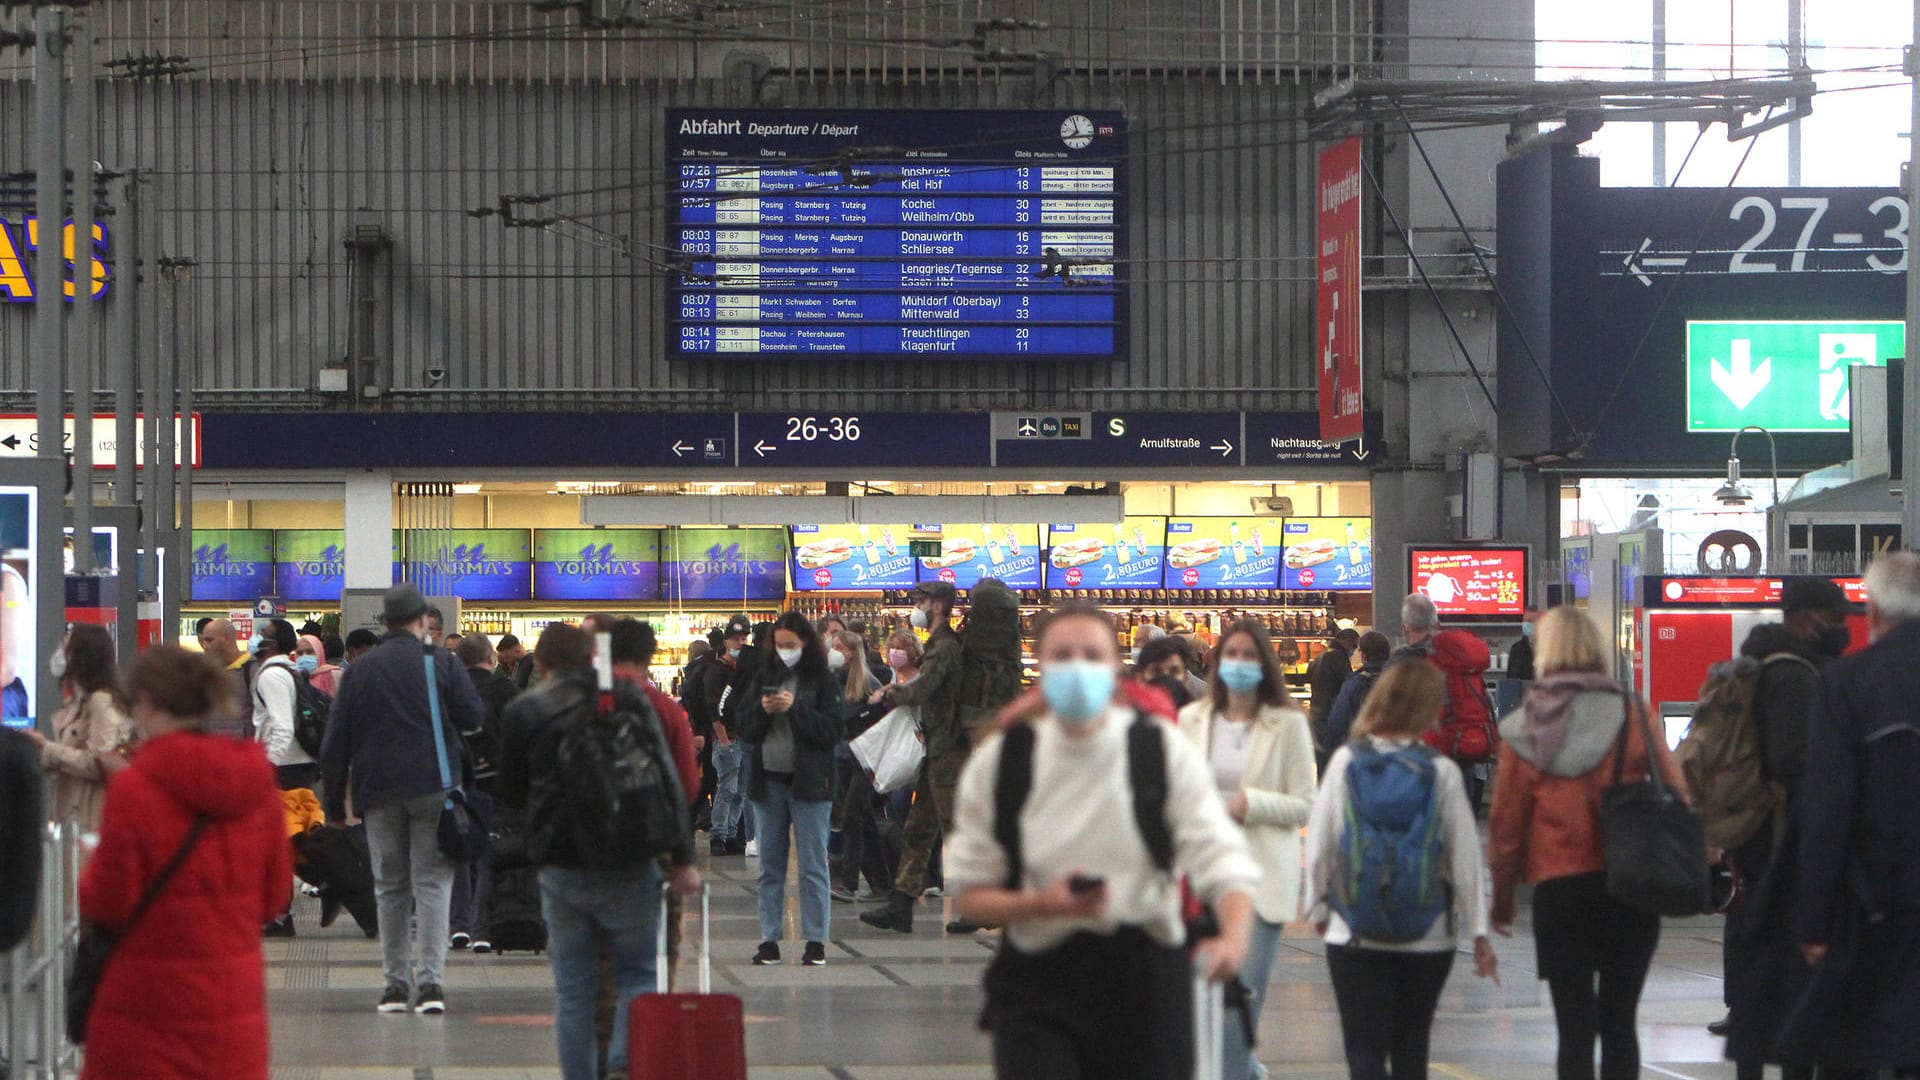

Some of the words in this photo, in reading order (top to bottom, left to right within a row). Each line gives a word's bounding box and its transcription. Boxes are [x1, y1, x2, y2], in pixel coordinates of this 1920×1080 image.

[680, 119, 741, 135] Abfahrt
[748, 123, 809, 137] Departure
[821, 124, 858, 137] Départ
[760, 148, 776, 156] Über
[901, 167, 950, 177] Innsbruck
[1016, 167, 1030, 177] 13
[682, 179, 710, 189] 07:57
[761, 182, 794, 190] Augsburg
[901, 180, 920, 190] Kiel
[925, 180, 942, 190] Hbf
[1016, 180, 1030, 190] 18
[761, 201, 784, 210] Pasing
[795, 201, 830, 210] Starnberg
[841, 201, 866, 210] Tutzing
[901, 200, 936, 209] Kochel
[1016, 200, 1030, 209] 30
[761, 214, 784, 223] Pasing
[795, 214, 830, 223] Starnberg
[841, 214, 866, 223] Tutzing
[901, 212, 974, 222] Weilheim/Obb
[1016, 212, 1030, 222] 30
[682, 230, 710, 241] 08:03
[761, 234, 784, 243] Pasing
[795, 234, 819, 243] Mering
[830, 234, 864, 243] Augsburg
[901, 231, 964, 242] Donauwörth
[1016, 232, 1030, 242] 16
[682, 243, 710, 253] 08:03
[761, 247, 821, 255] Donnersbergerbr.
[832, 247, 856, 255] Harras
[901, 245, 954, 255] Schliersee
[1016, 245, 1030, 255] 32
[716, 264, 725, 272] RB
[730, 264, 752, 272] 56/57
[761, 266, 821, 275] Donnersbergerbr.
[832, 266, 856, 275] Harras
[901, 264, 1002, 276] Lenggries/Tegernse
[1016, 264, 1030, 274] 32
[936, 276, 954, 287] Hbf
[682, 295, 710, 305] 08:07
[716, 296, 725, 304] RB
[761, 298, 783, 306] Markt
[786, 298, 822, 306] Schwaben
[832, 298, 856, 306] Dorfen
[901, 296, 948, 306] Mühldorf
[952, 296, 1002, 308] (Oberbay)
[1022, 296, 1030, 306] 8
[682, 308, 710, 318] 08:13
[761, 311, 784, 320] Pasing
[795, 311, 826, 320] Weilheim
[838, 311, 864, 320] Murnau
[901, 309, 960, 319] Mittenwald
[1016, 309, 1030, 319] 33
[682, 327, 710, 337] 08:14
[761, 330, 786, 338] Dachau
[798, 330, 845, 338] Petershausen
[902, 328, 970, 340] Treuchtlingen
[1016, 328, 1030, 339] 20
[682, 340, 710, 350] 08:17
[761, 343, 798, 351] Rosenheim
[809, 343, 846, 351] Traunstein
[901, 341, 956, 353] Klagenfurt
[1016, 341, 1030, 351] 11
[786, 417, 860, 441] 26-36
[1043, 423, 1056, 431] Bus
[1064, 423, 1079, 431] TAXI
[1110, 418, 1124, 437] S
[1140, 437, 1200, 449] Arnulfstraße
[554, 561, 641, 576] YORMA'S
[681, 561, 768, 576] YORMA'S
[852, 563, 884, 581] 2,80
[884, 556, 912, 572] EURO
[1007, 556, 1034, 572] EURO
[1103, 563, 1131, 581] 2,80
[1132, 556, 1158, 572] EURO
[1220, 563, 1248, 581] 2,80
[1249, 556, 1274, 573] EURO
[1335, 564, 1364, 581] 2,80
[1660, 628, 1674, 639] DB
